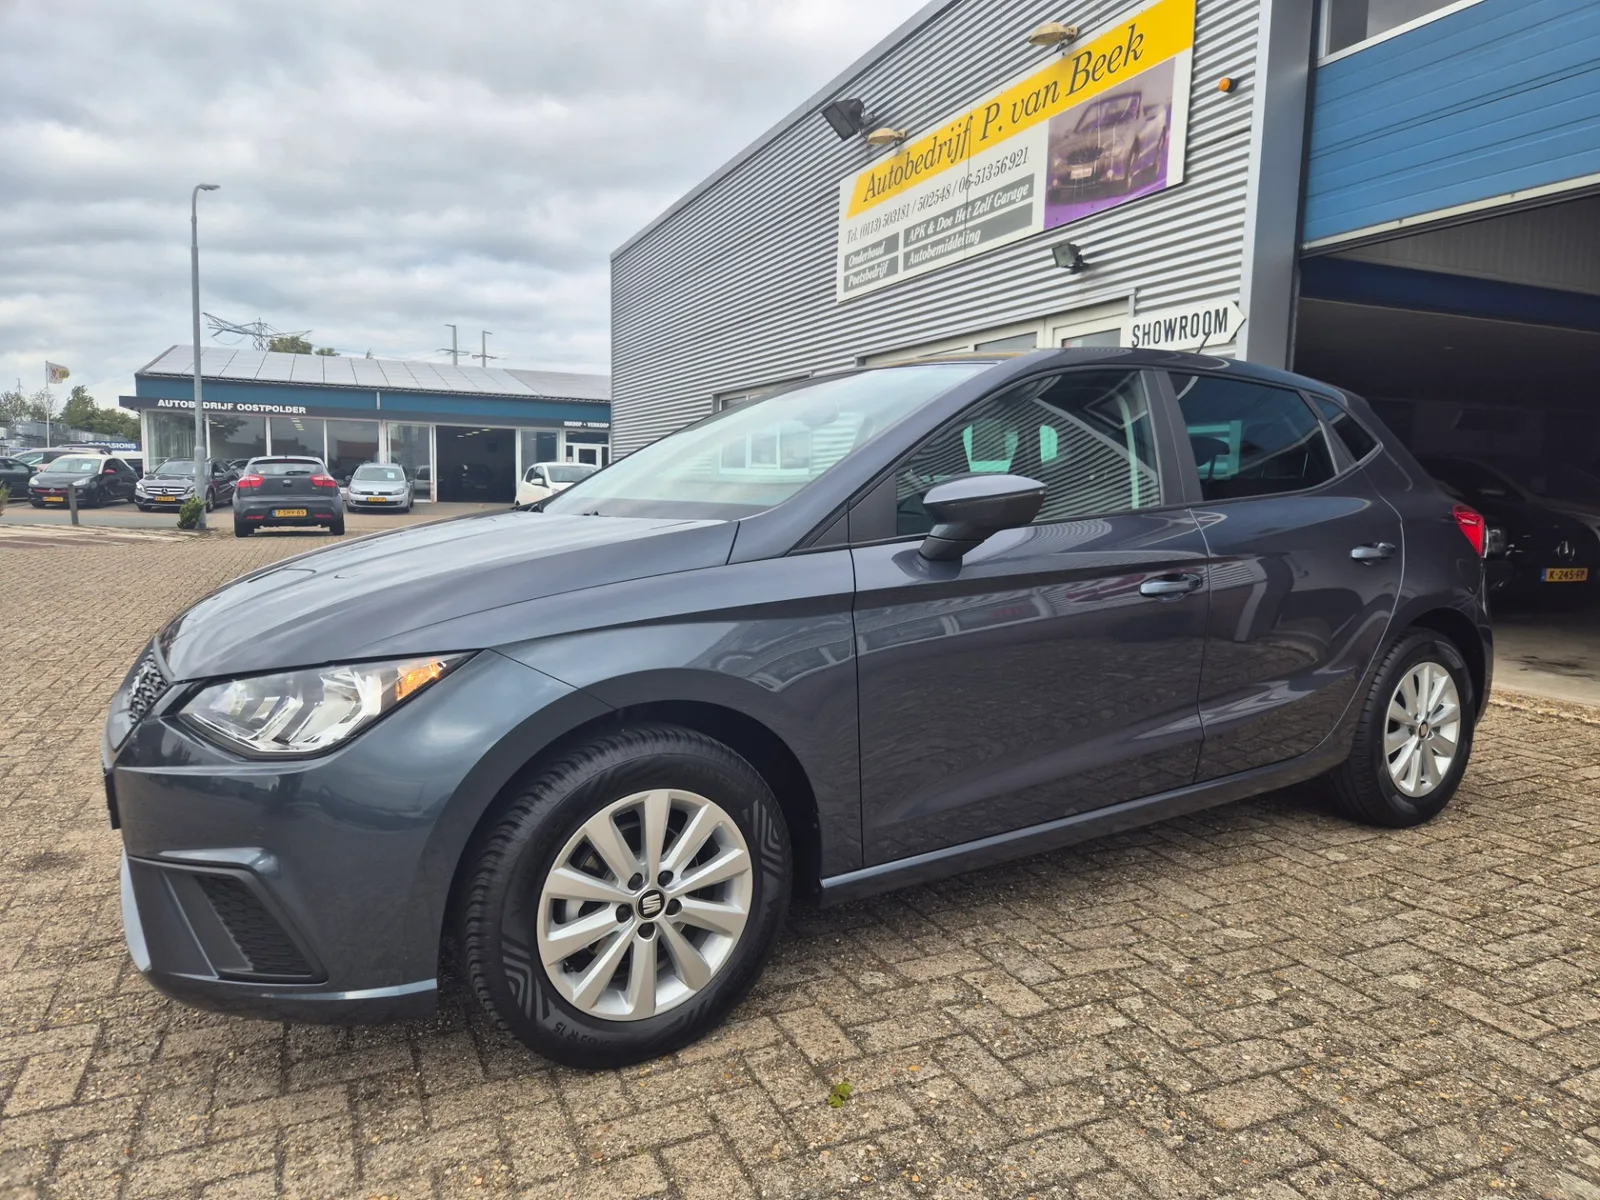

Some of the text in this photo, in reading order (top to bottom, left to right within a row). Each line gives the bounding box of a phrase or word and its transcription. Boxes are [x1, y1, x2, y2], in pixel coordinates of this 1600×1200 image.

[863, 23, 1144, 203] Autobedrijf P. van Beek
[847, 227, 858, 244] Tel.
[860, 217, 881, 240] (0113)
[882, 203, 910, 228] 503181
[917, 183, 951, 212] 502548
[908, 183, 1030, 243] APK & Doe Het Zelf Garage
[848, 241, 886, 267] Onderhoud
[908, 229, 981, 266] Autobemiddeling
[848, 260, 889, 288] Poetsbedrijf
[1132, 307, 1228, 348] SHOWROOM
[157, 399, 306, 414] AUTOBDRIJF OOSTPOLDER
